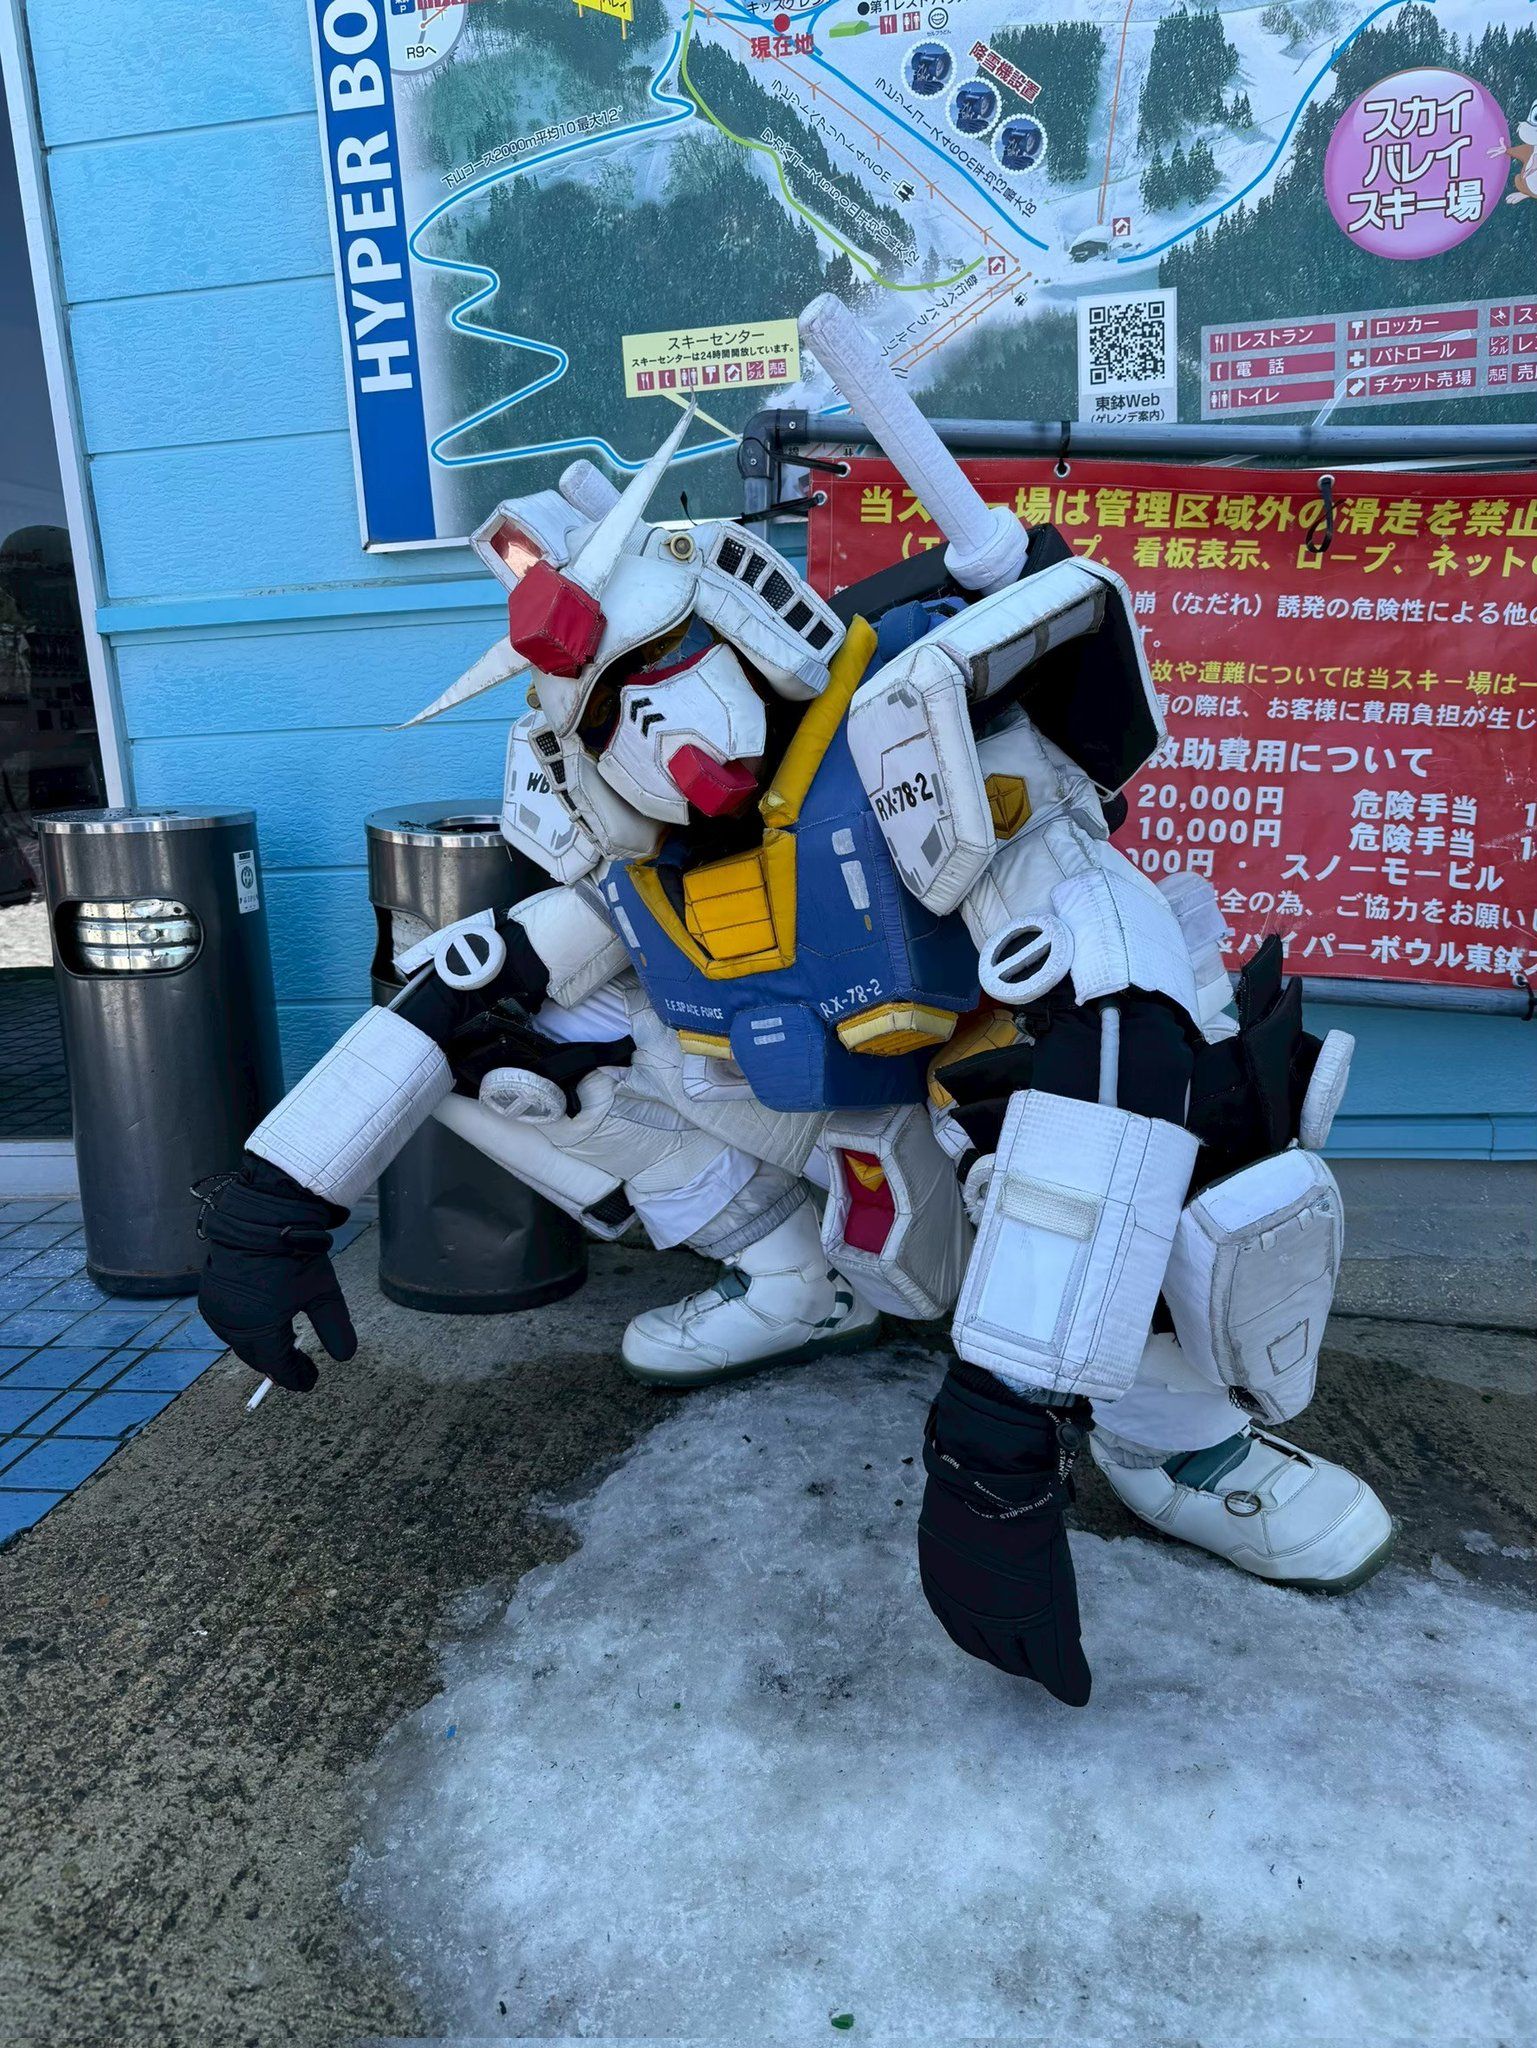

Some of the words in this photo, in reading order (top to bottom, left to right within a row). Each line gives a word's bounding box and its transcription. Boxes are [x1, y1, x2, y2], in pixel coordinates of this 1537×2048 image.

[750, 34, 815, 59] 現在地
[969, 42, 1041, 102] 降雪機設置
[1364, 90, 1473, 143] スカイ
[1363, 135, 1472, 187] バレイ
[1347, 178, 1485, 233] スキー場
[337, 130, 413, 393] HYPER
[1376, 317, 1440, 335] ロッカー
[1518, 308, 1537, 322] ス
[668, 329, 765, 351] スキーセンター
[1237, 328, 1314, 348] レストラン
[1519, 336, 1537, 351] レ
[1375, 343, 1457, 363] パトロール
[769, 361, 786, 376] 売店
[1488, 367, 1507, 382] 売店
[1517, 364, 1537, 381] 売
[1374, 370, 1472, 393] チケット売場
[1095, 392, 1160, 412] 東鉢Web
[1237, 387, 1280, 406] トイレ
[860, 486, 1537, 537] 当スー場は管理区域外の滑走を禁止
[875, 772, 934, 822] RX-78-2
[1137, 783, 1285, 816] 20,000円
[1351, 788, 1478, 827] 危険手当
[1138, 816, 1282, 849] 10,000円
[1349, 822, 1475, 859] 危険手当
[820, 978, 883, 1019] RX-78-2
[701, 1006, 724, 1020] FORCE
